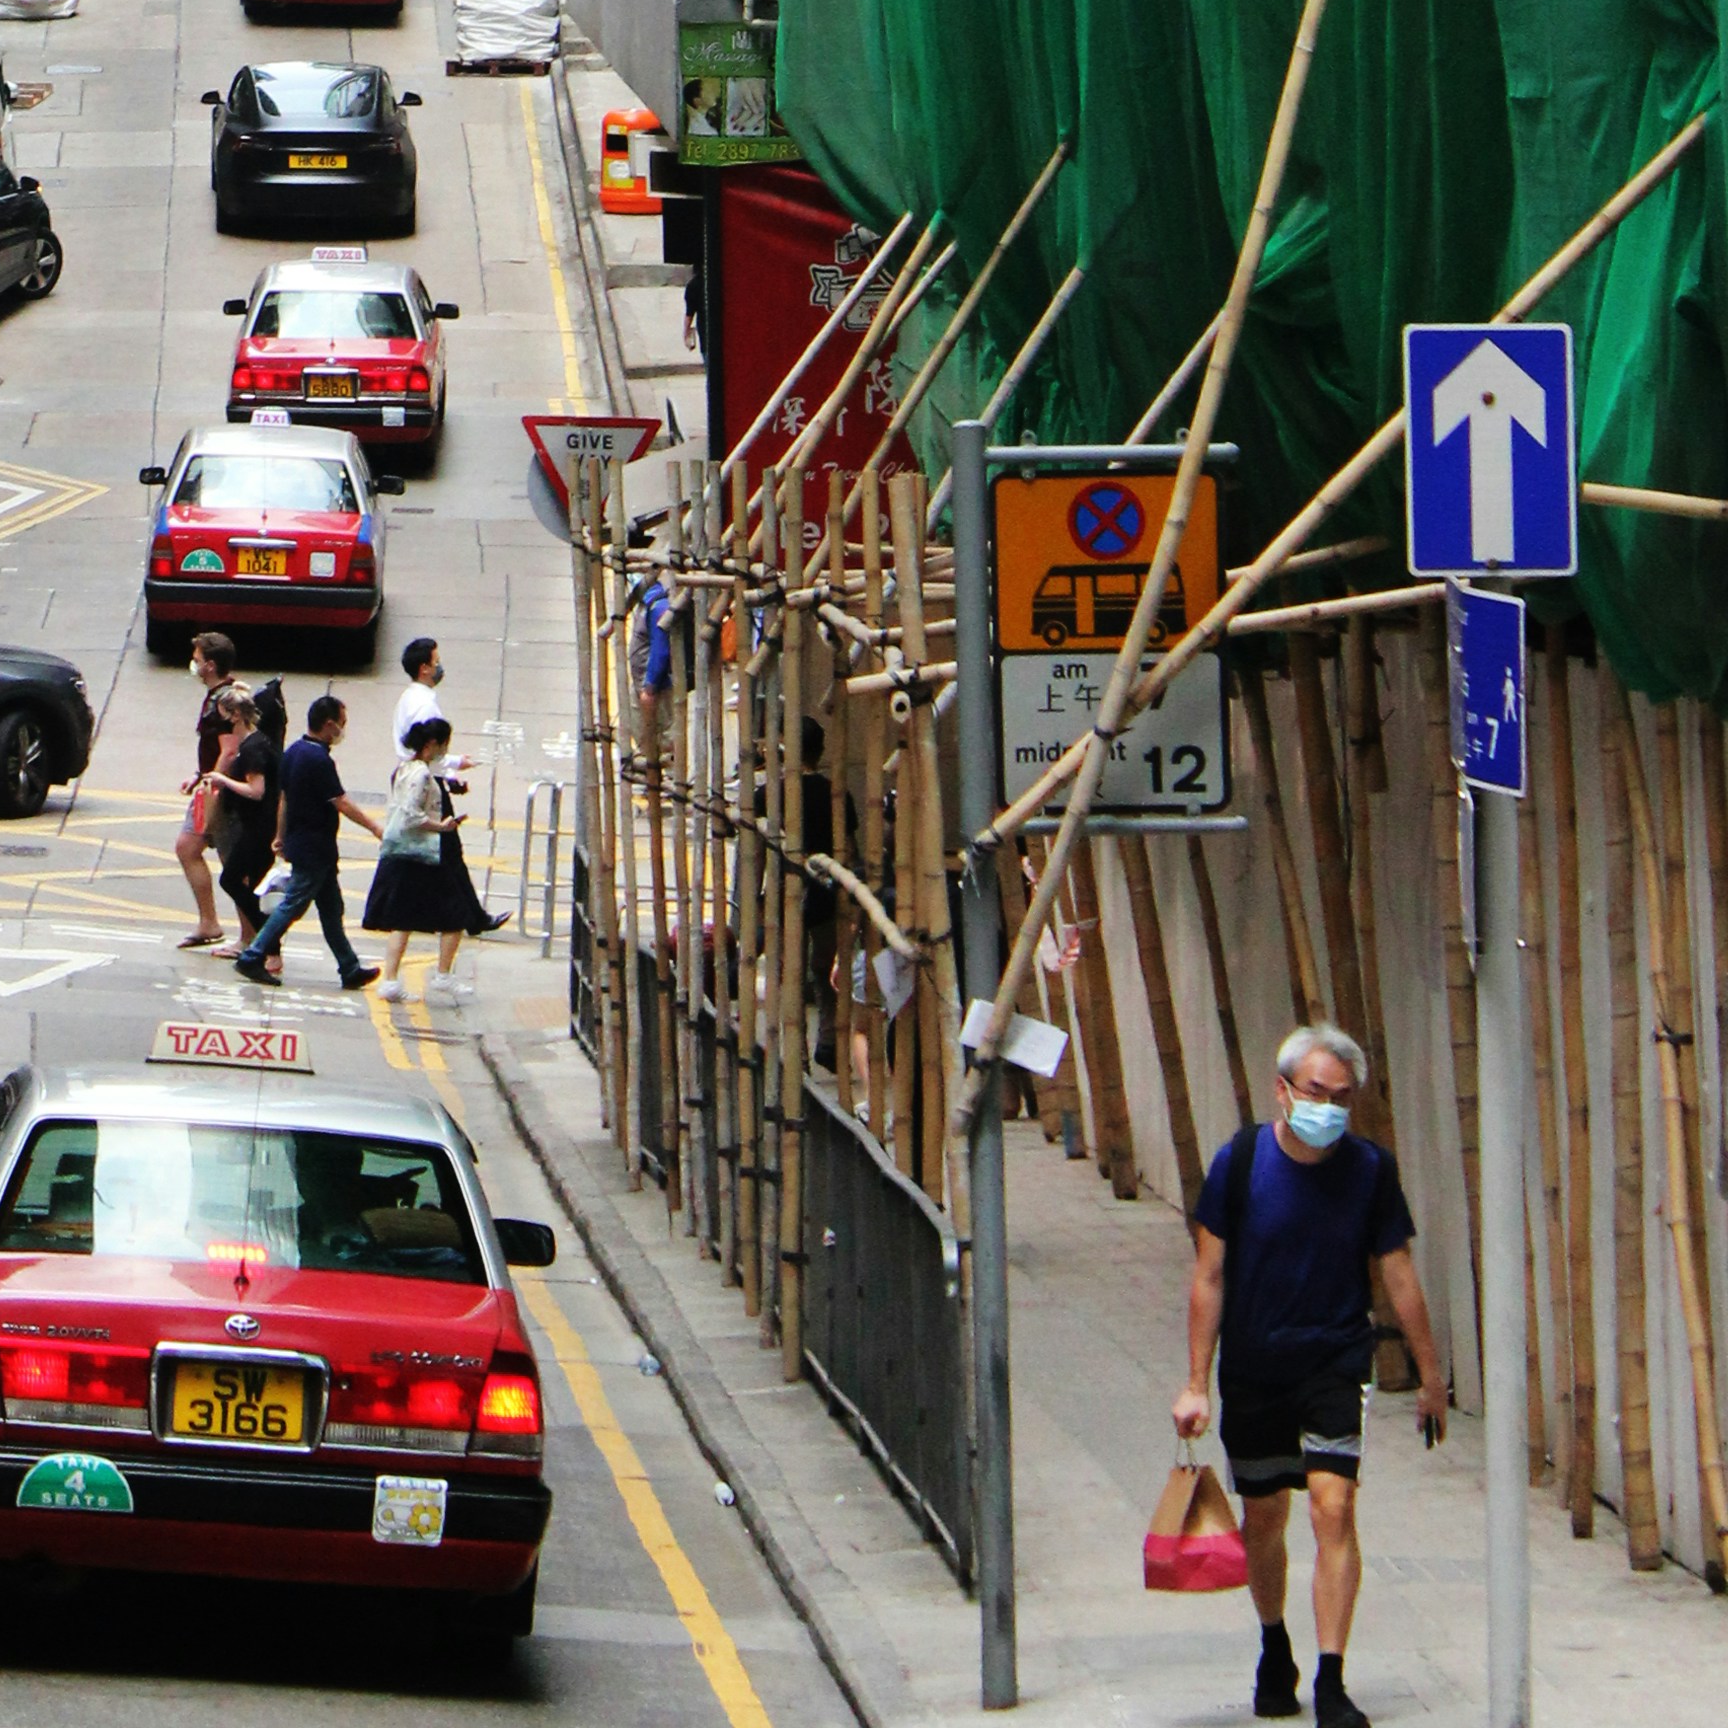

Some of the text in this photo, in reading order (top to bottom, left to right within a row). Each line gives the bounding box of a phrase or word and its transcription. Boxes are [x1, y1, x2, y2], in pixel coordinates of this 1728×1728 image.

[315, 249, 362, 261] TAXI
[255, 413, 286, 424] TAXI
[566, 433, 614, 450] GIVE
[246, 559, 278, 574] 1041
[1052, 662, 1088, 680] am
[1037, 683, 1102, 713] 上午
[1485, 716, 1499, 761] 7
[1143, 744, 1207, 794] 12
[167, 1025, 298, 1062] TAXI
[213, 1367, 268, 1404] SW
[188, 1399, 288, 1437] 3166
[63, 1469, 87, 1494] 4
[41, 1492, 109, 1508] SEATS
